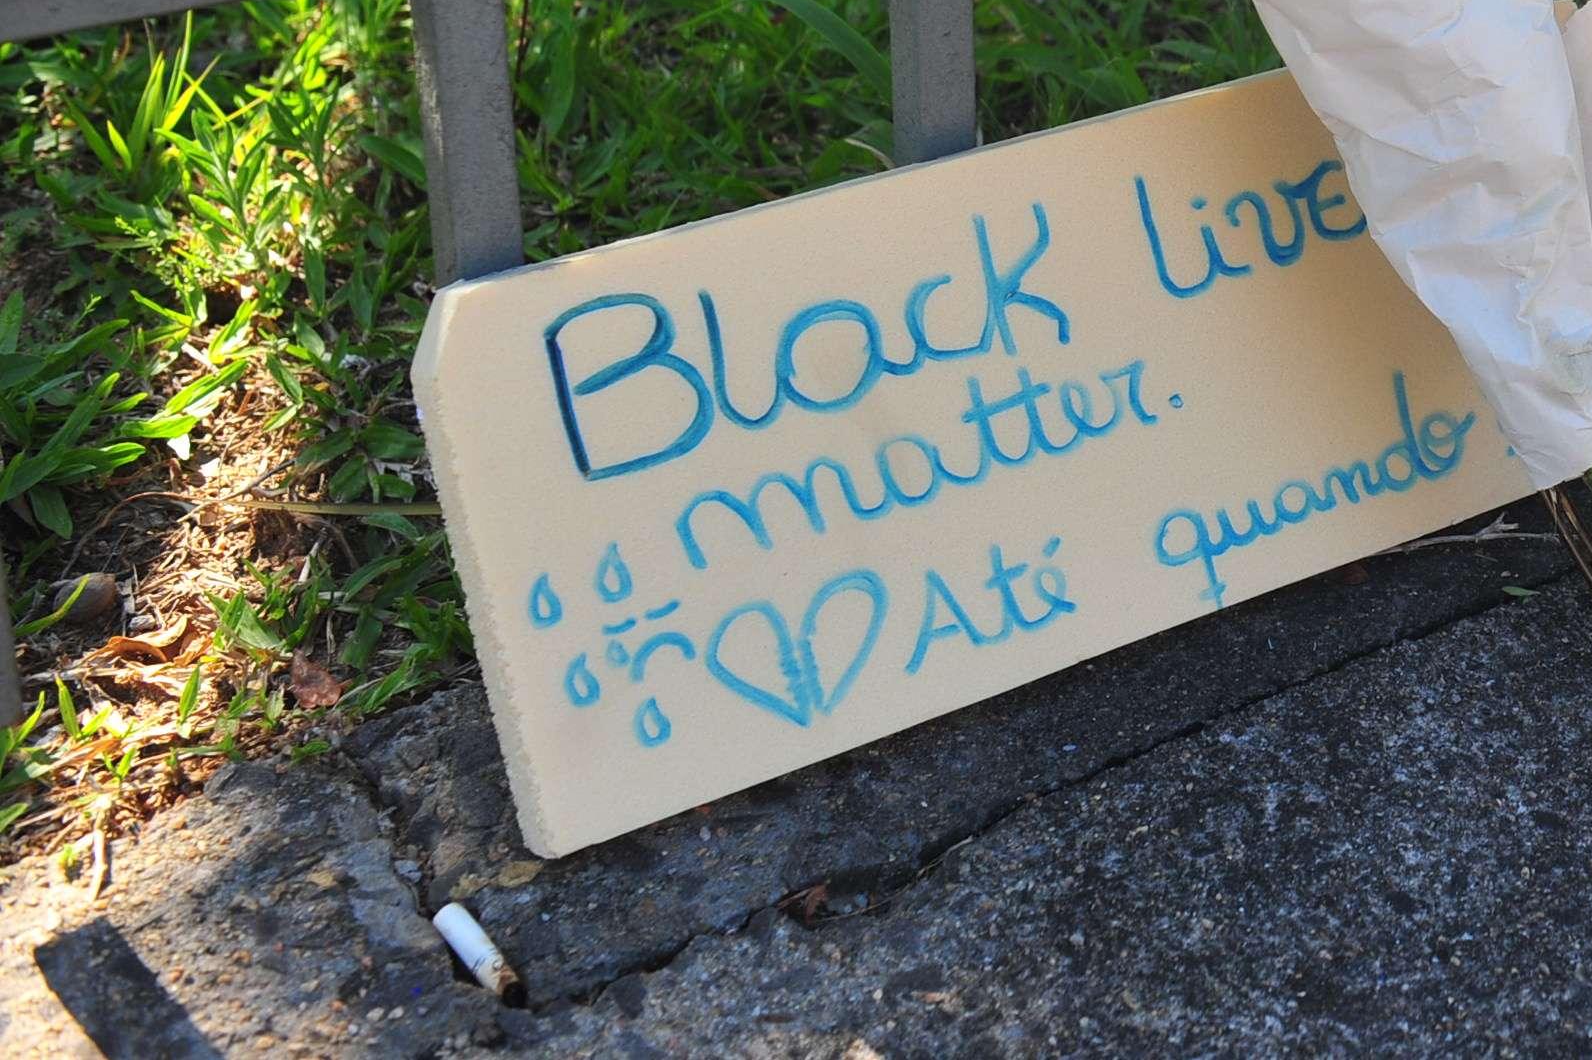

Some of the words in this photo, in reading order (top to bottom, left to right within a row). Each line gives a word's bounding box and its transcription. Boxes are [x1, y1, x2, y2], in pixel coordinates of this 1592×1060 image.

[543, 202, 1071, 482] Black
[1134, 159, 1368, 299] live
[674, 360, 1186, 570] matter.
[903, 535, 1078, 675] Até
[1154, 370, 1478, 609] quando
